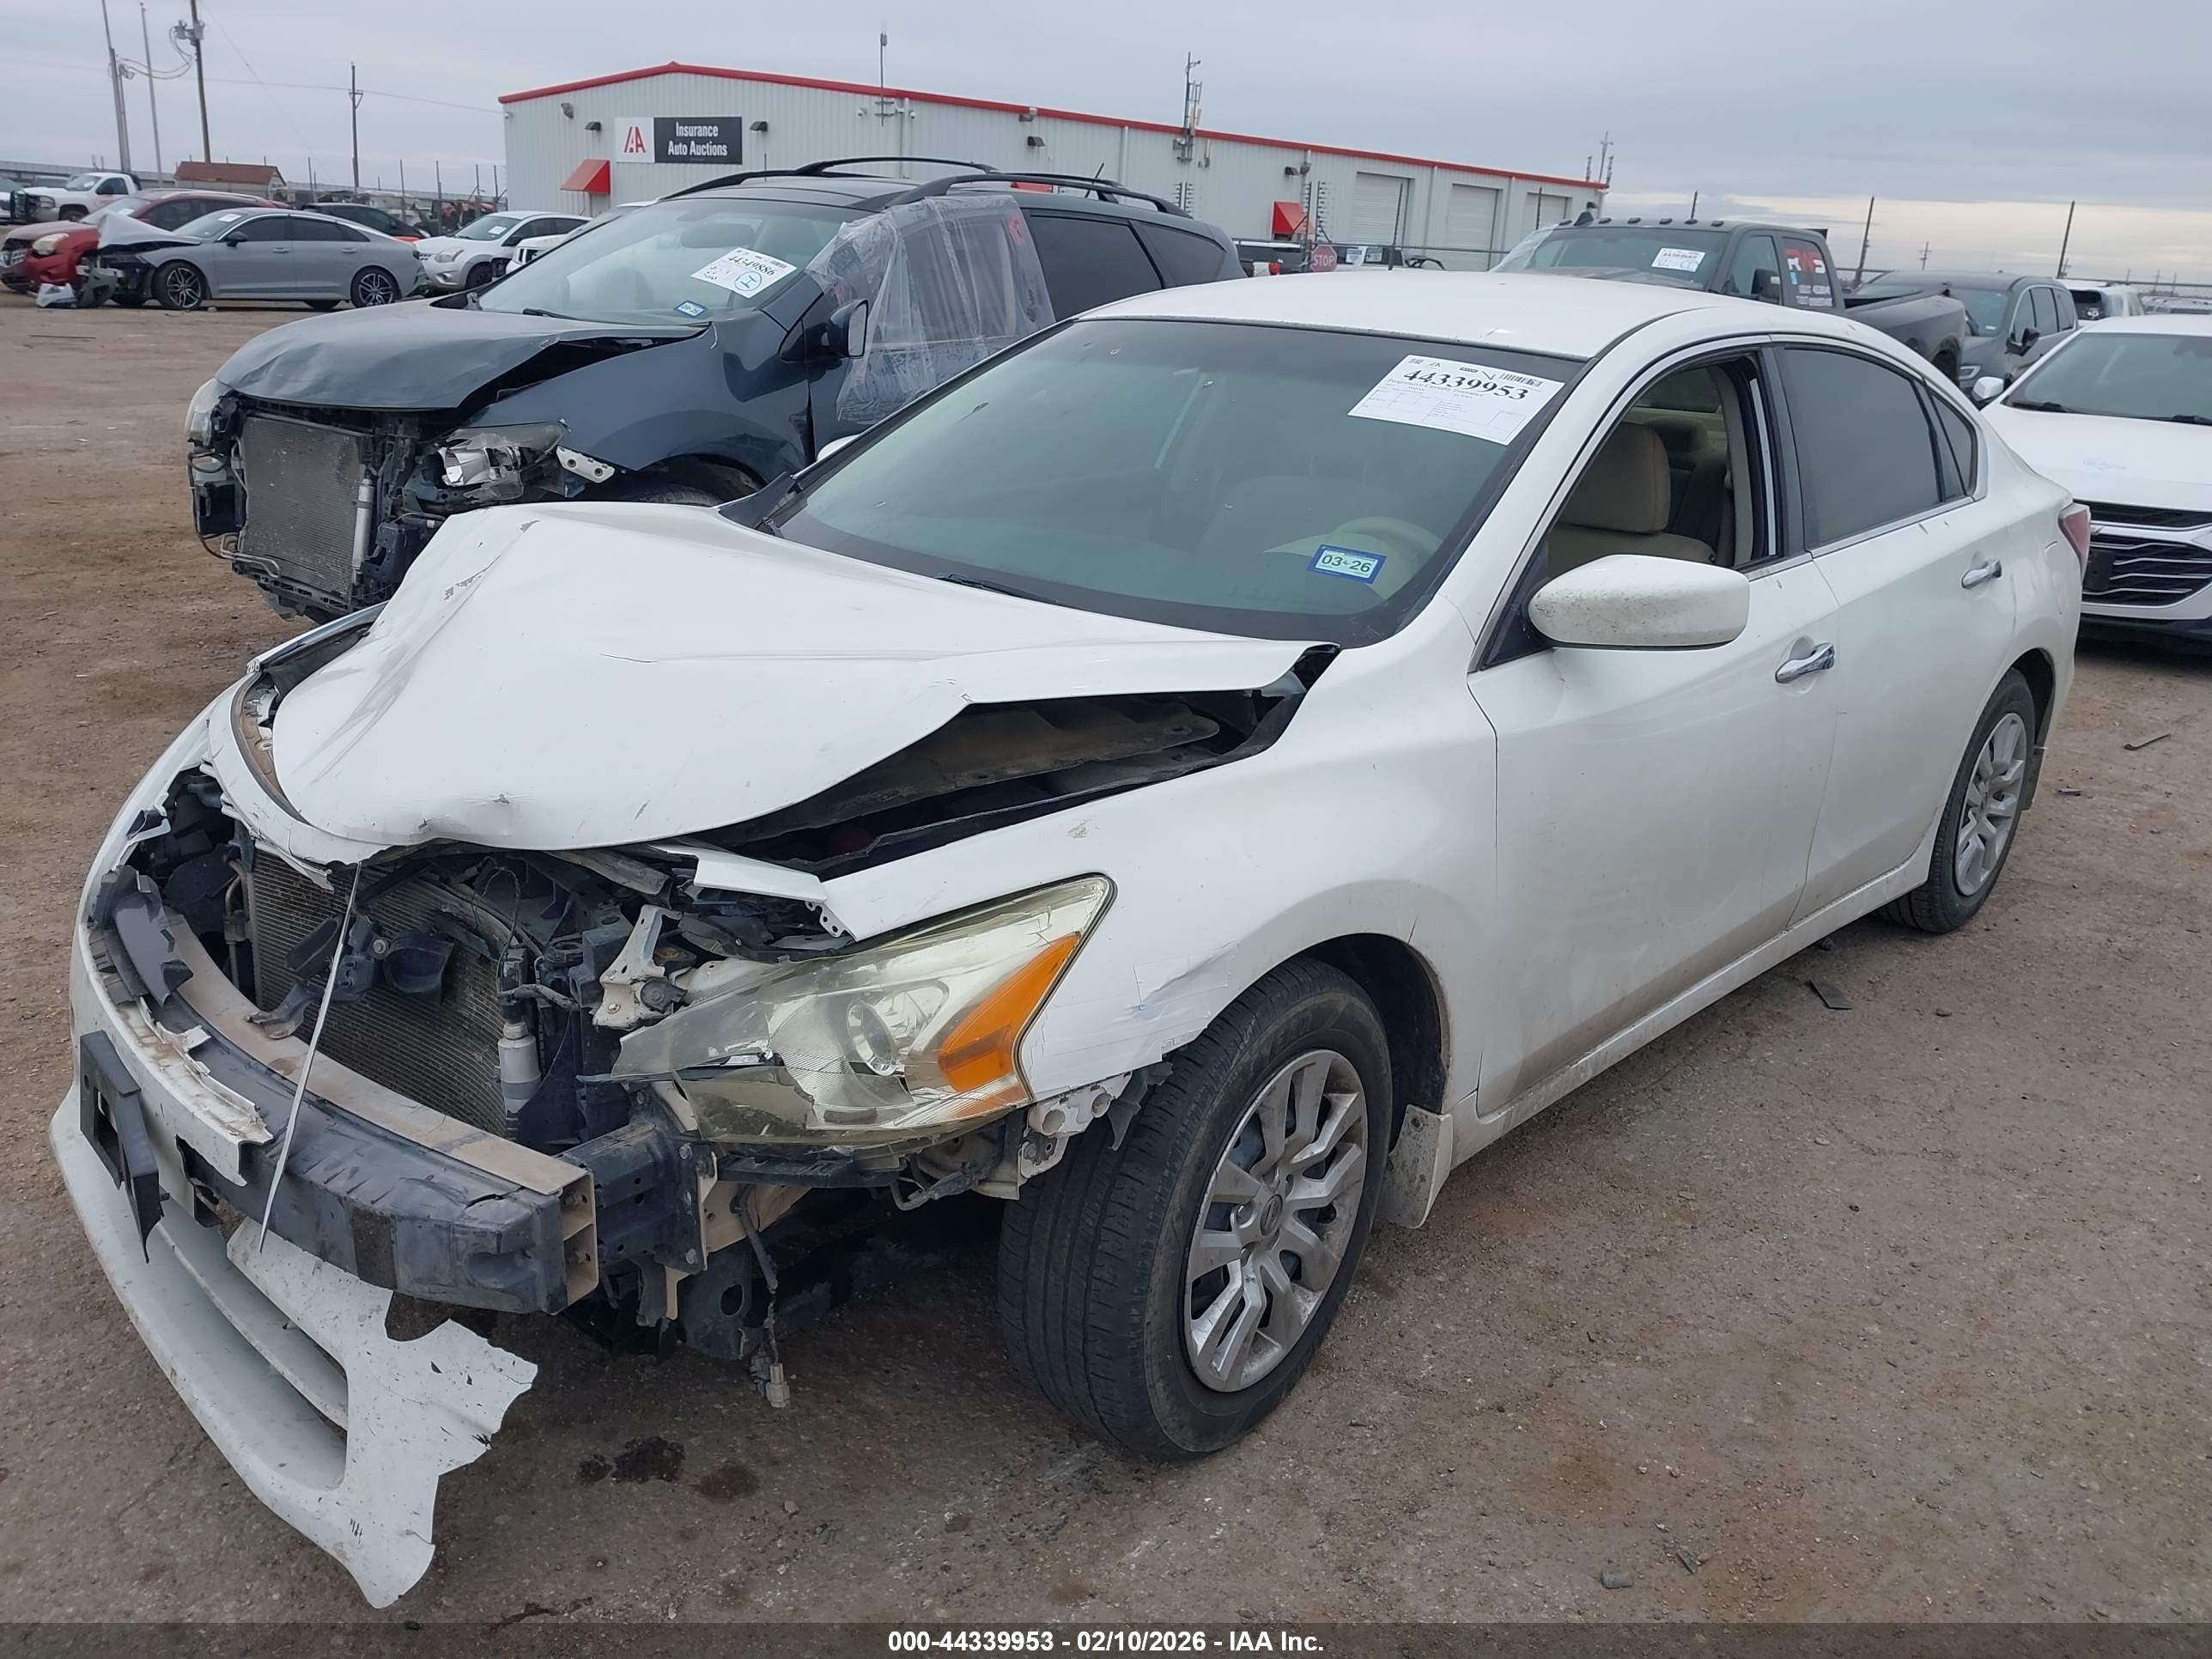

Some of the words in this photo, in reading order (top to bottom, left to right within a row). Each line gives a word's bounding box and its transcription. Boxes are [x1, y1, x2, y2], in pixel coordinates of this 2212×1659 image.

[675, 121, 719, 137] Insurance
[667, 140, 688, 156] Auto
[690, 140, 728, 156] Auctions
[1313, 254, 1334, 267] STOP
[1404, 369, 1528, 400] 44339953
